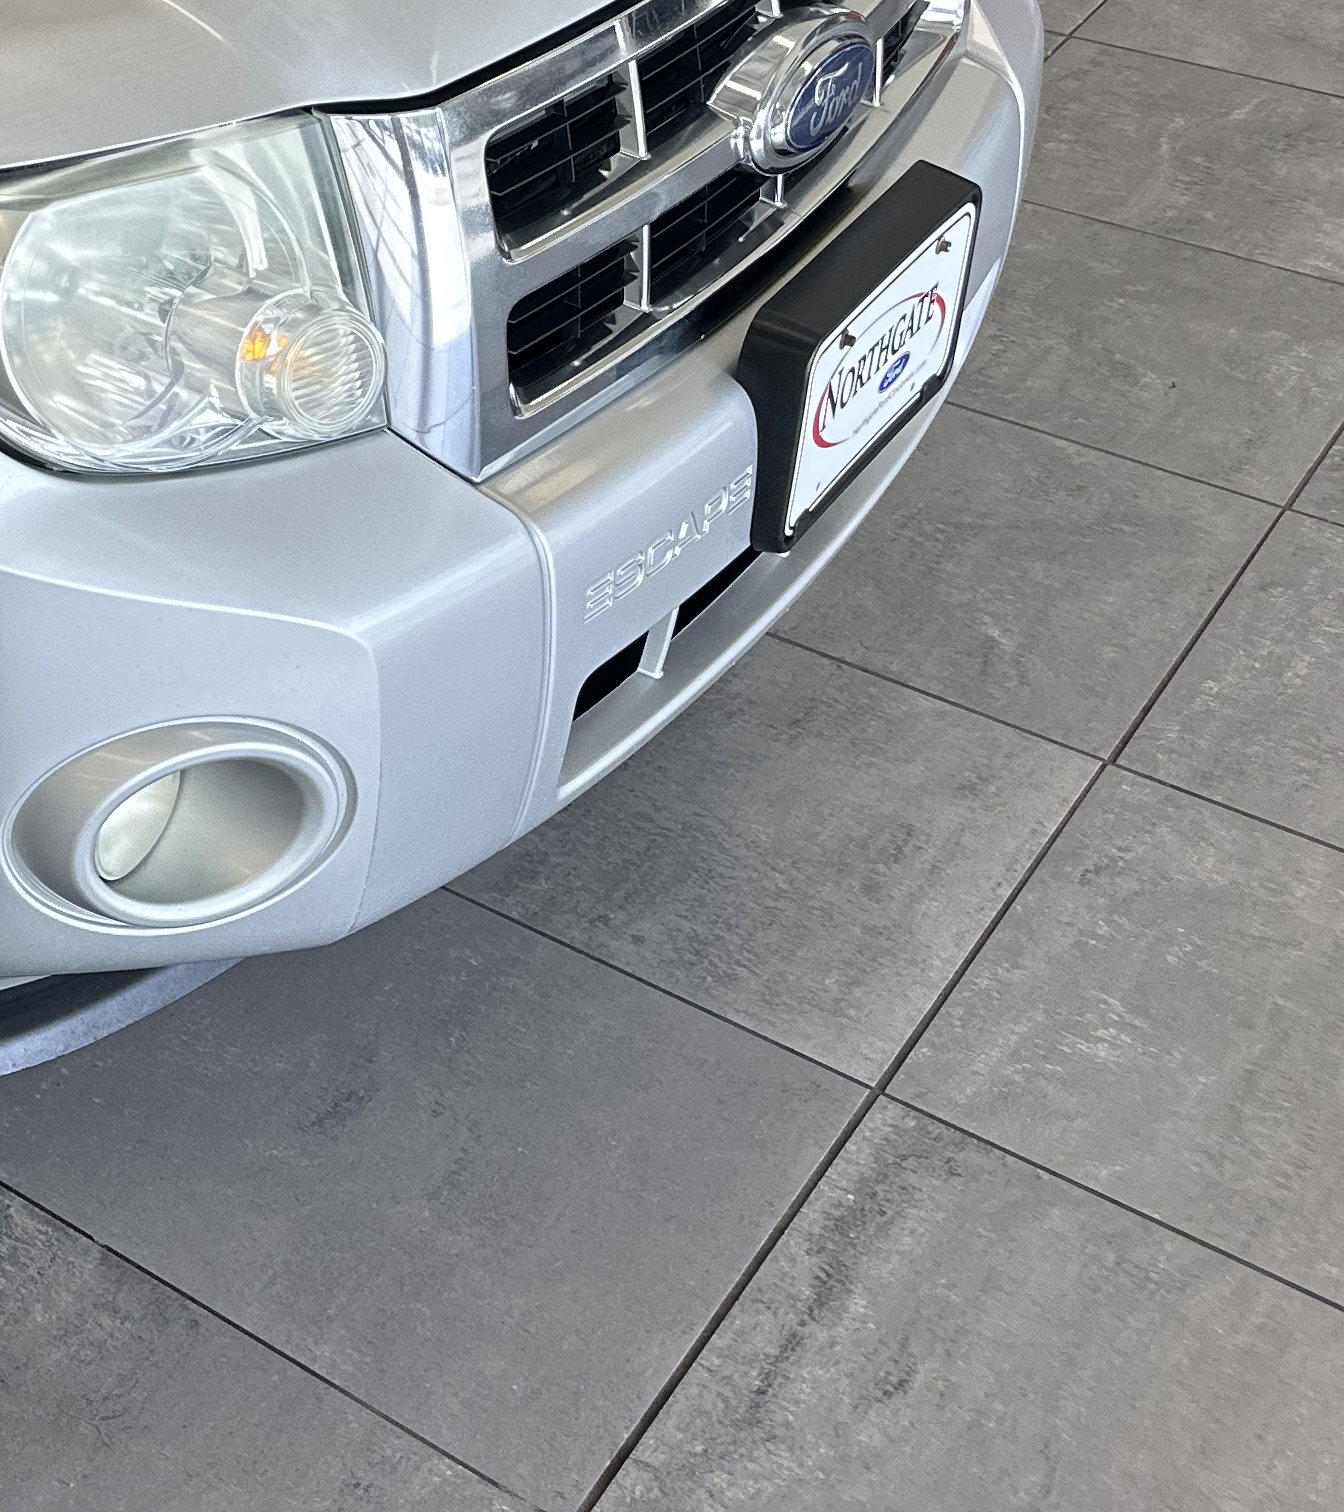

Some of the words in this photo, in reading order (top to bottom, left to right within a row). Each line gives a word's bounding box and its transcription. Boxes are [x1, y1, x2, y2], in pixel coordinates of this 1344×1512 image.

[808, 61, 864, 137] Ford
[819, 281, 940, 433] NORTHGATE
[583, 464, 753, 624] ESCAPE
